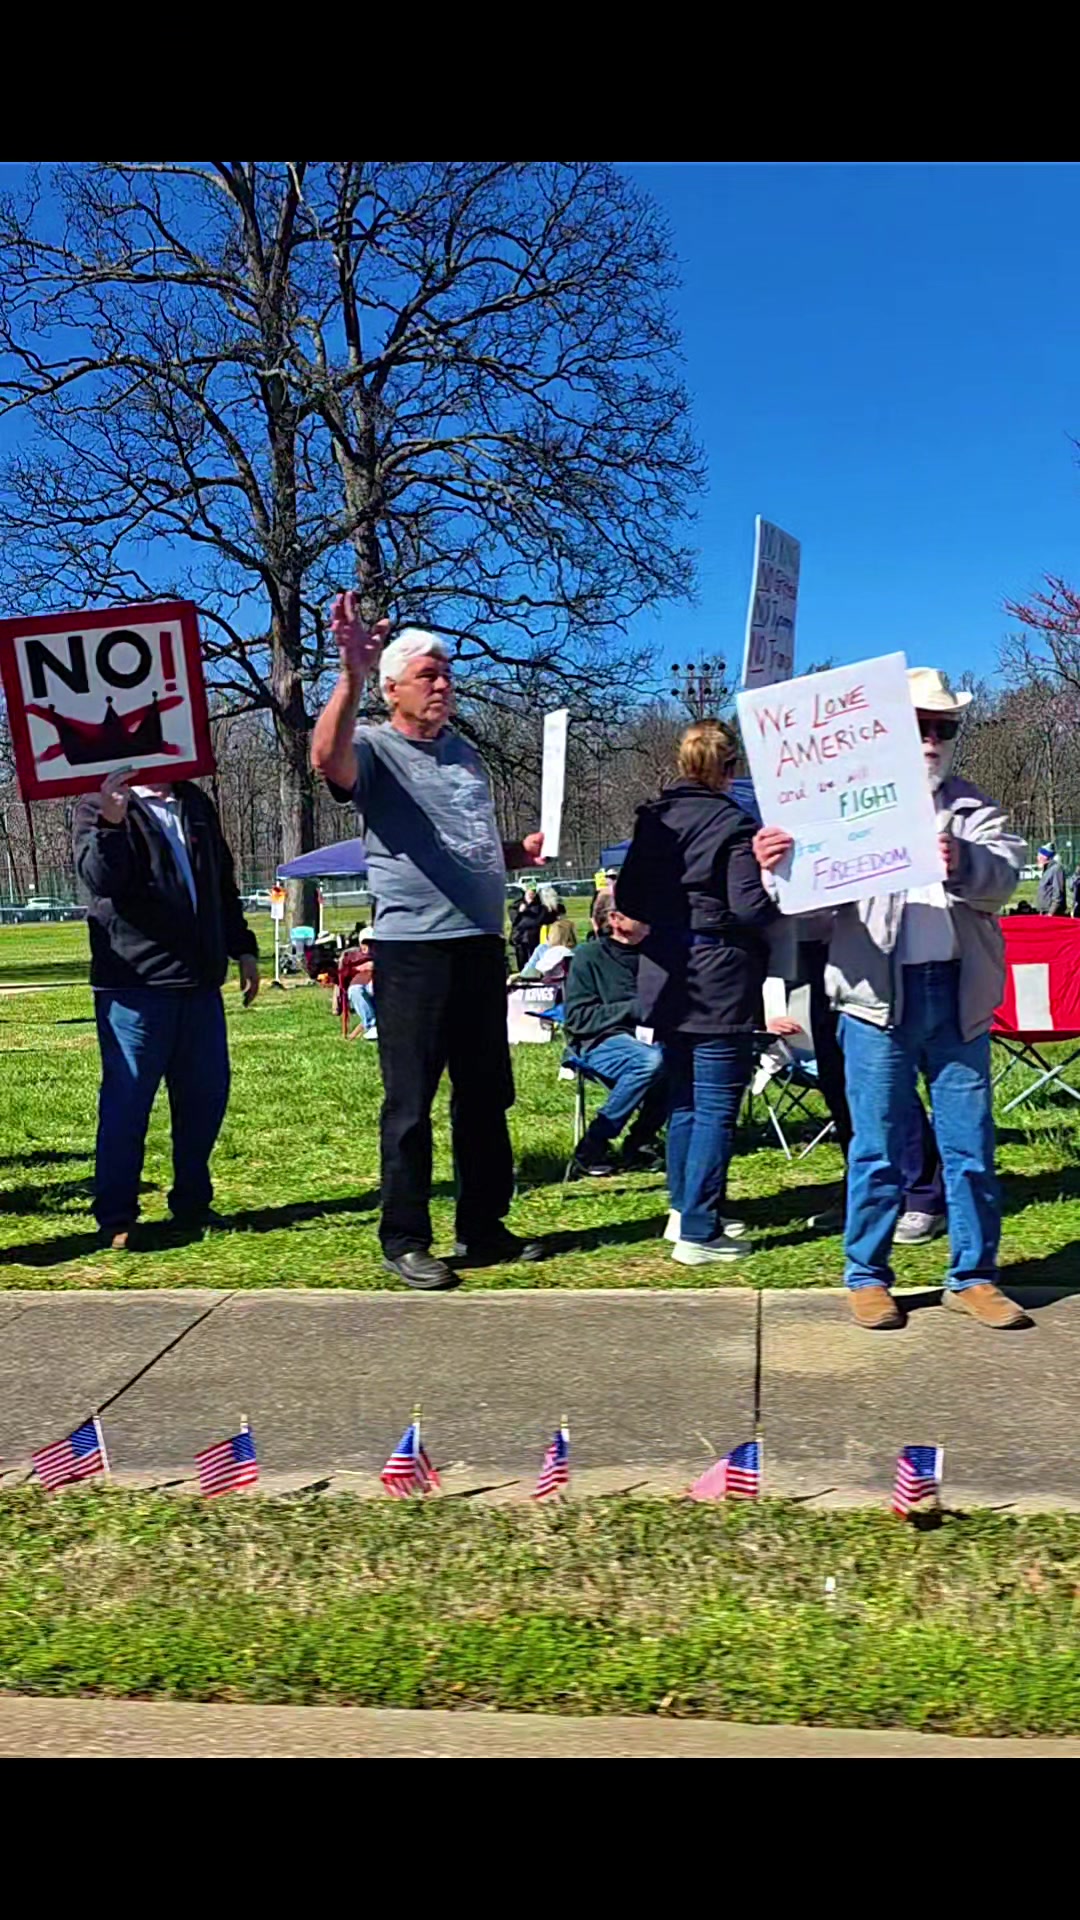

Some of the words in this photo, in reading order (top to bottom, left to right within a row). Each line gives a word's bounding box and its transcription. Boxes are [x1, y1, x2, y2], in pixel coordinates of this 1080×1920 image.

[24, 630, 178, 698] NO!
[812, 685, 867, 728] LOVE
[778, 780, 806, 804] and
[839, 782, 898, 818] FIGHT
[813, 847, 911, 890] FREEDOM
[525, 987, 555, 1001] KINGS
